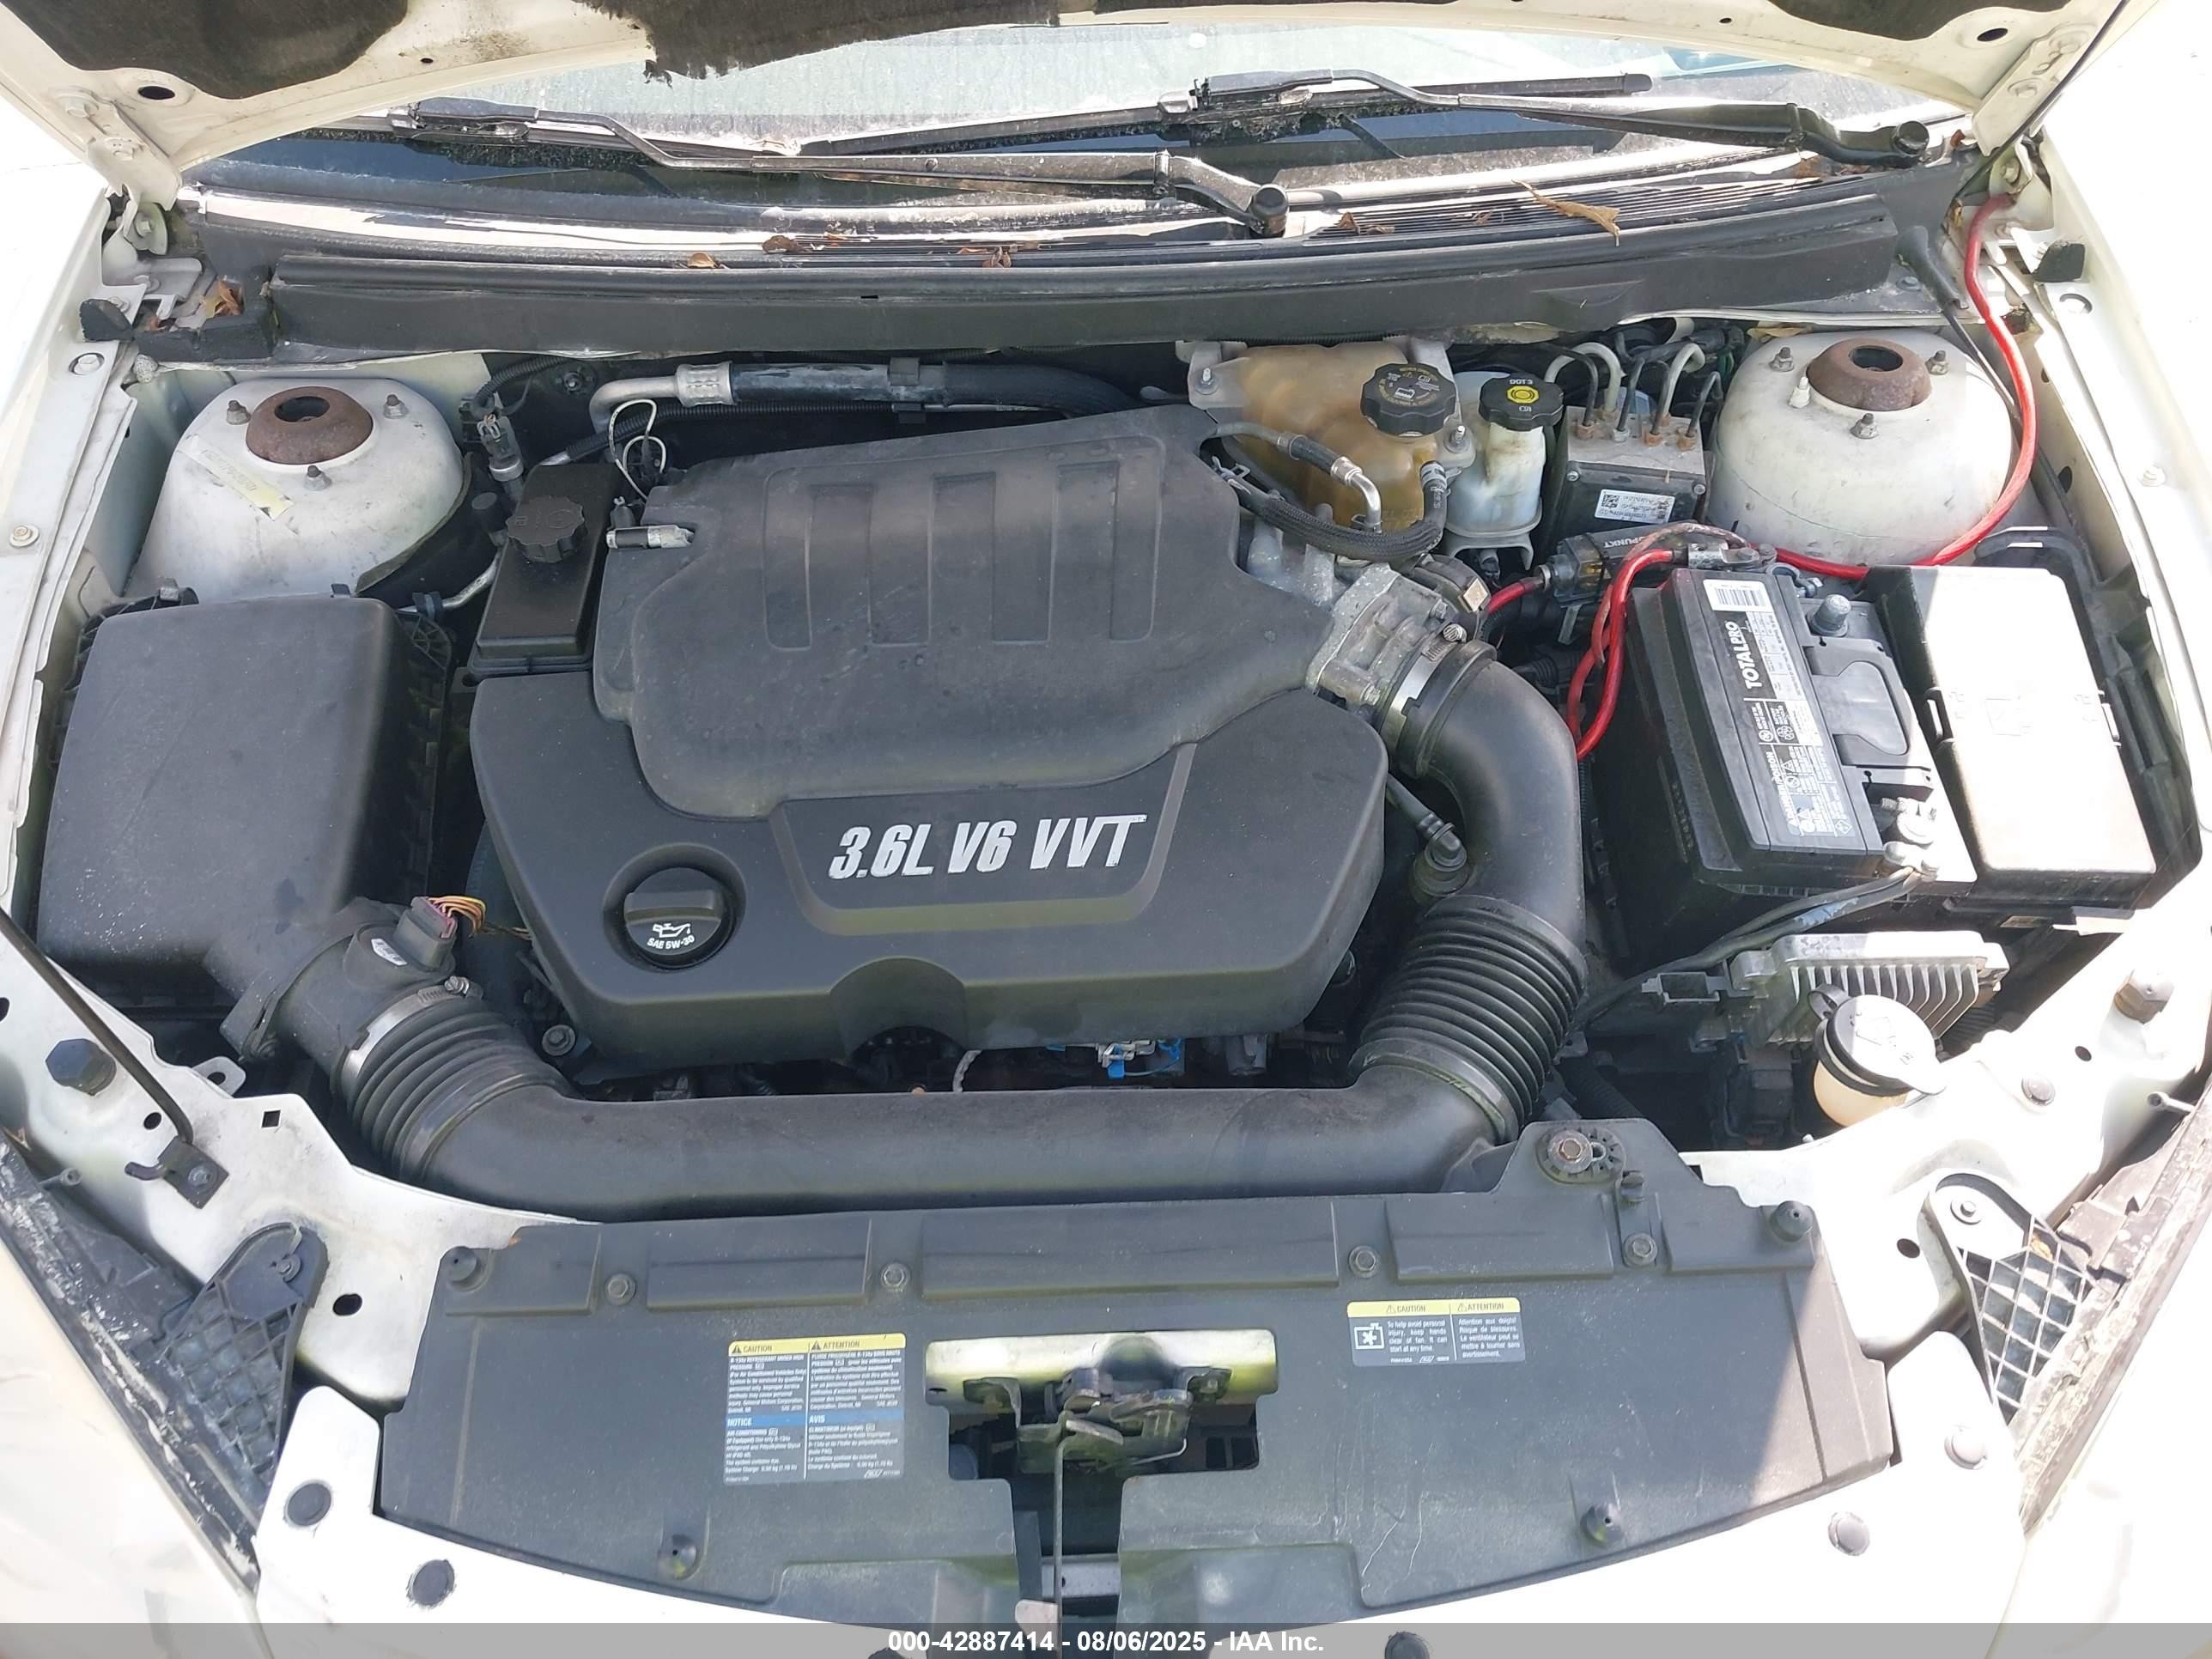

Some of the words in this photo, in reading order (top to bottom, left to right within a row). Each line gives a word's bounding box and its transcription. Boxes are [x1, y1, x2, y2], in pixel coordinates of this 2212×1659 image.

[827, 823, 934, 879] 3.6L
[948, 820, 1018, 873] V6
[1030, 814, 1147, 870] VVT
[647, 938, 665, 949] SAE
[665, 934, 695, 950] 5W-30
[823, 1340, 860, 1349] ATTENTION
[728, 1418, 751, 1426] NOTICE
[809, 1415, 825, 1424] AVIS
